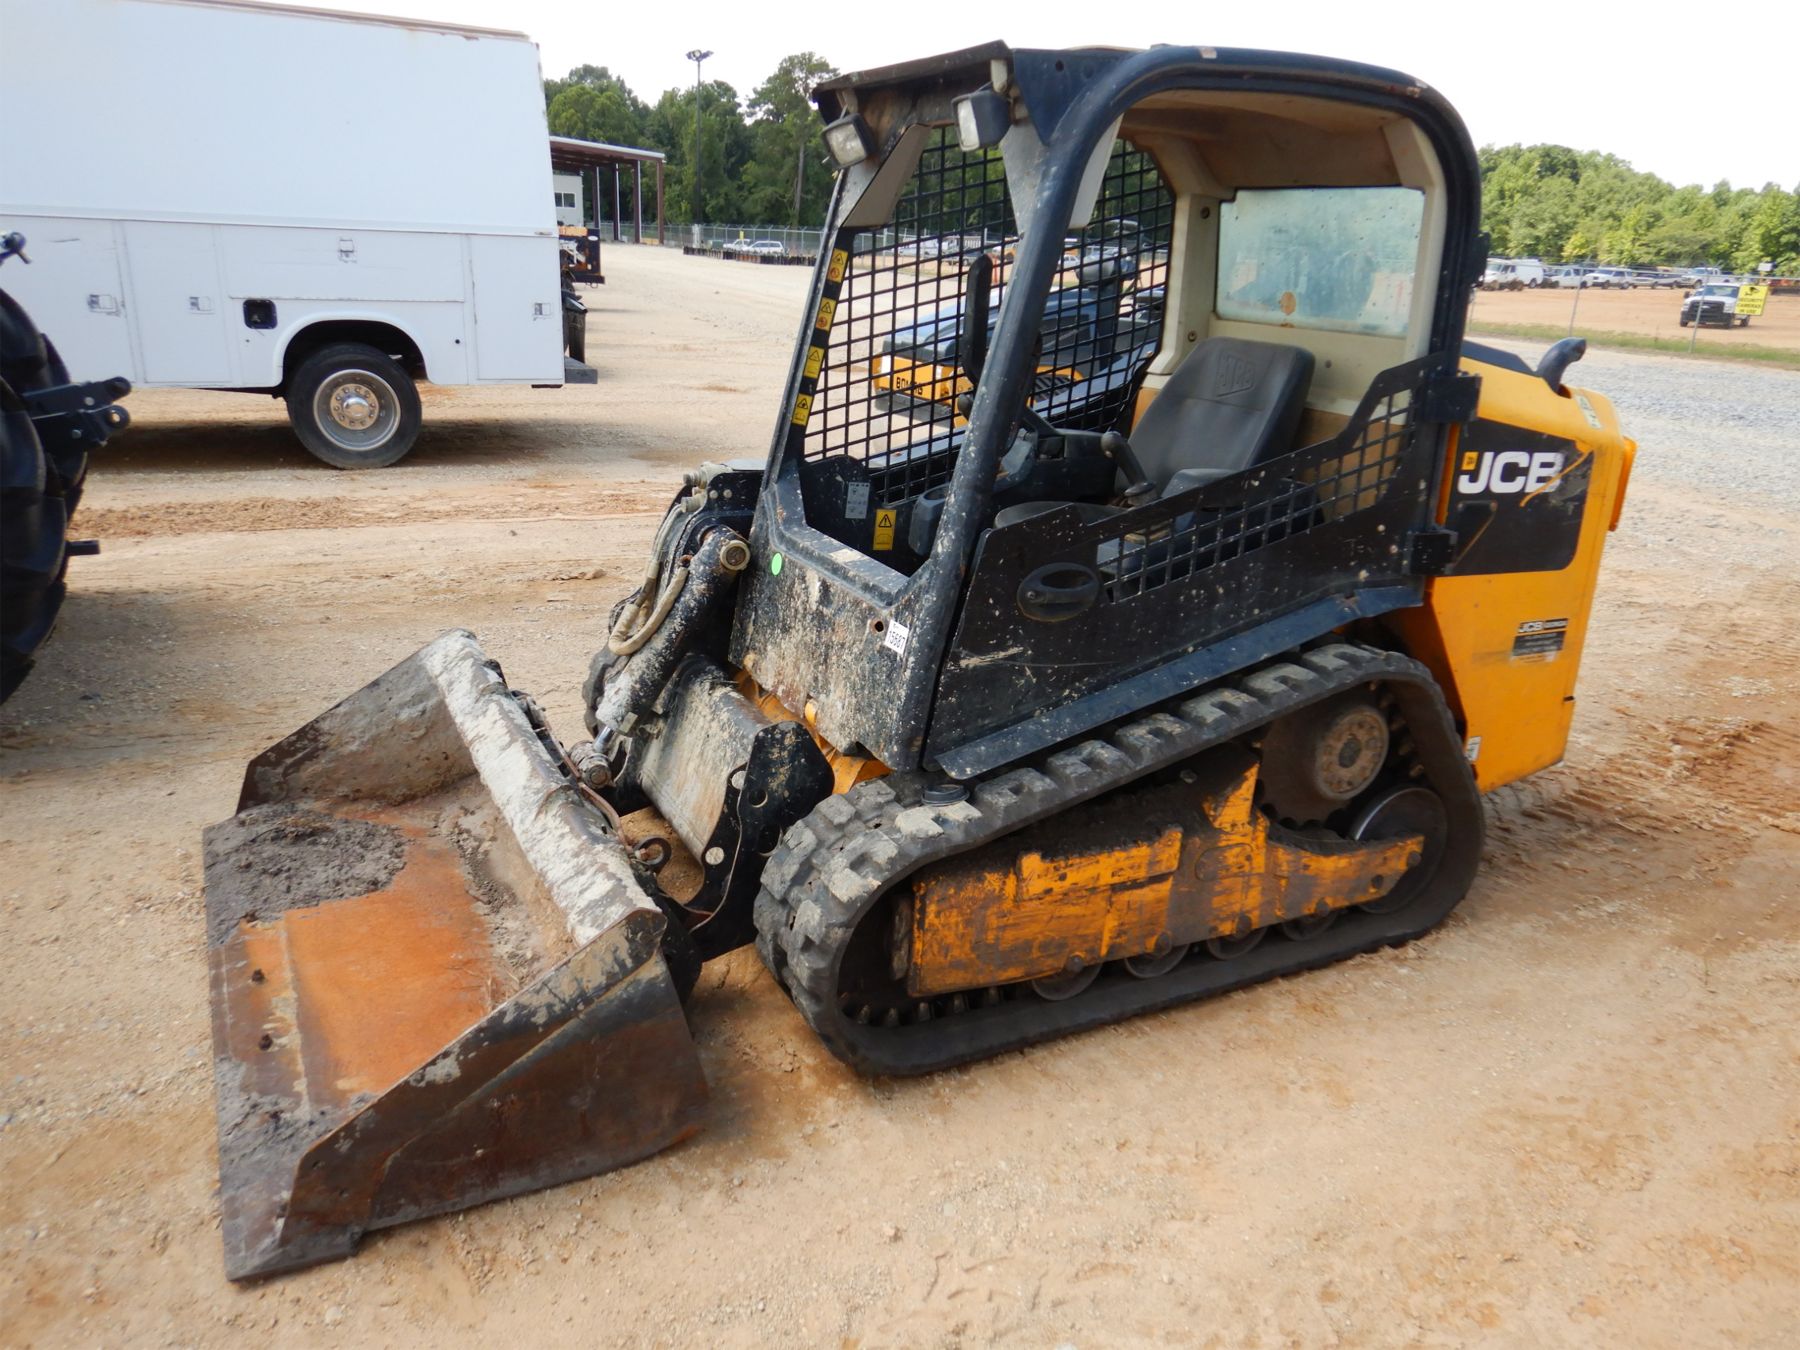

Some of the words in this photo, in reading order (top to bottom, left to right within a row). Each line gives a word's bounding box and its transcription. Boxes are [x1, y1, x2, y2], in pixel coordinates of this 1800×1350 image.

[896, 377, 923, 395] BOG
[1457, 451, 1565, 494] JCB
[1518, 621, 1543, 632] JCB
